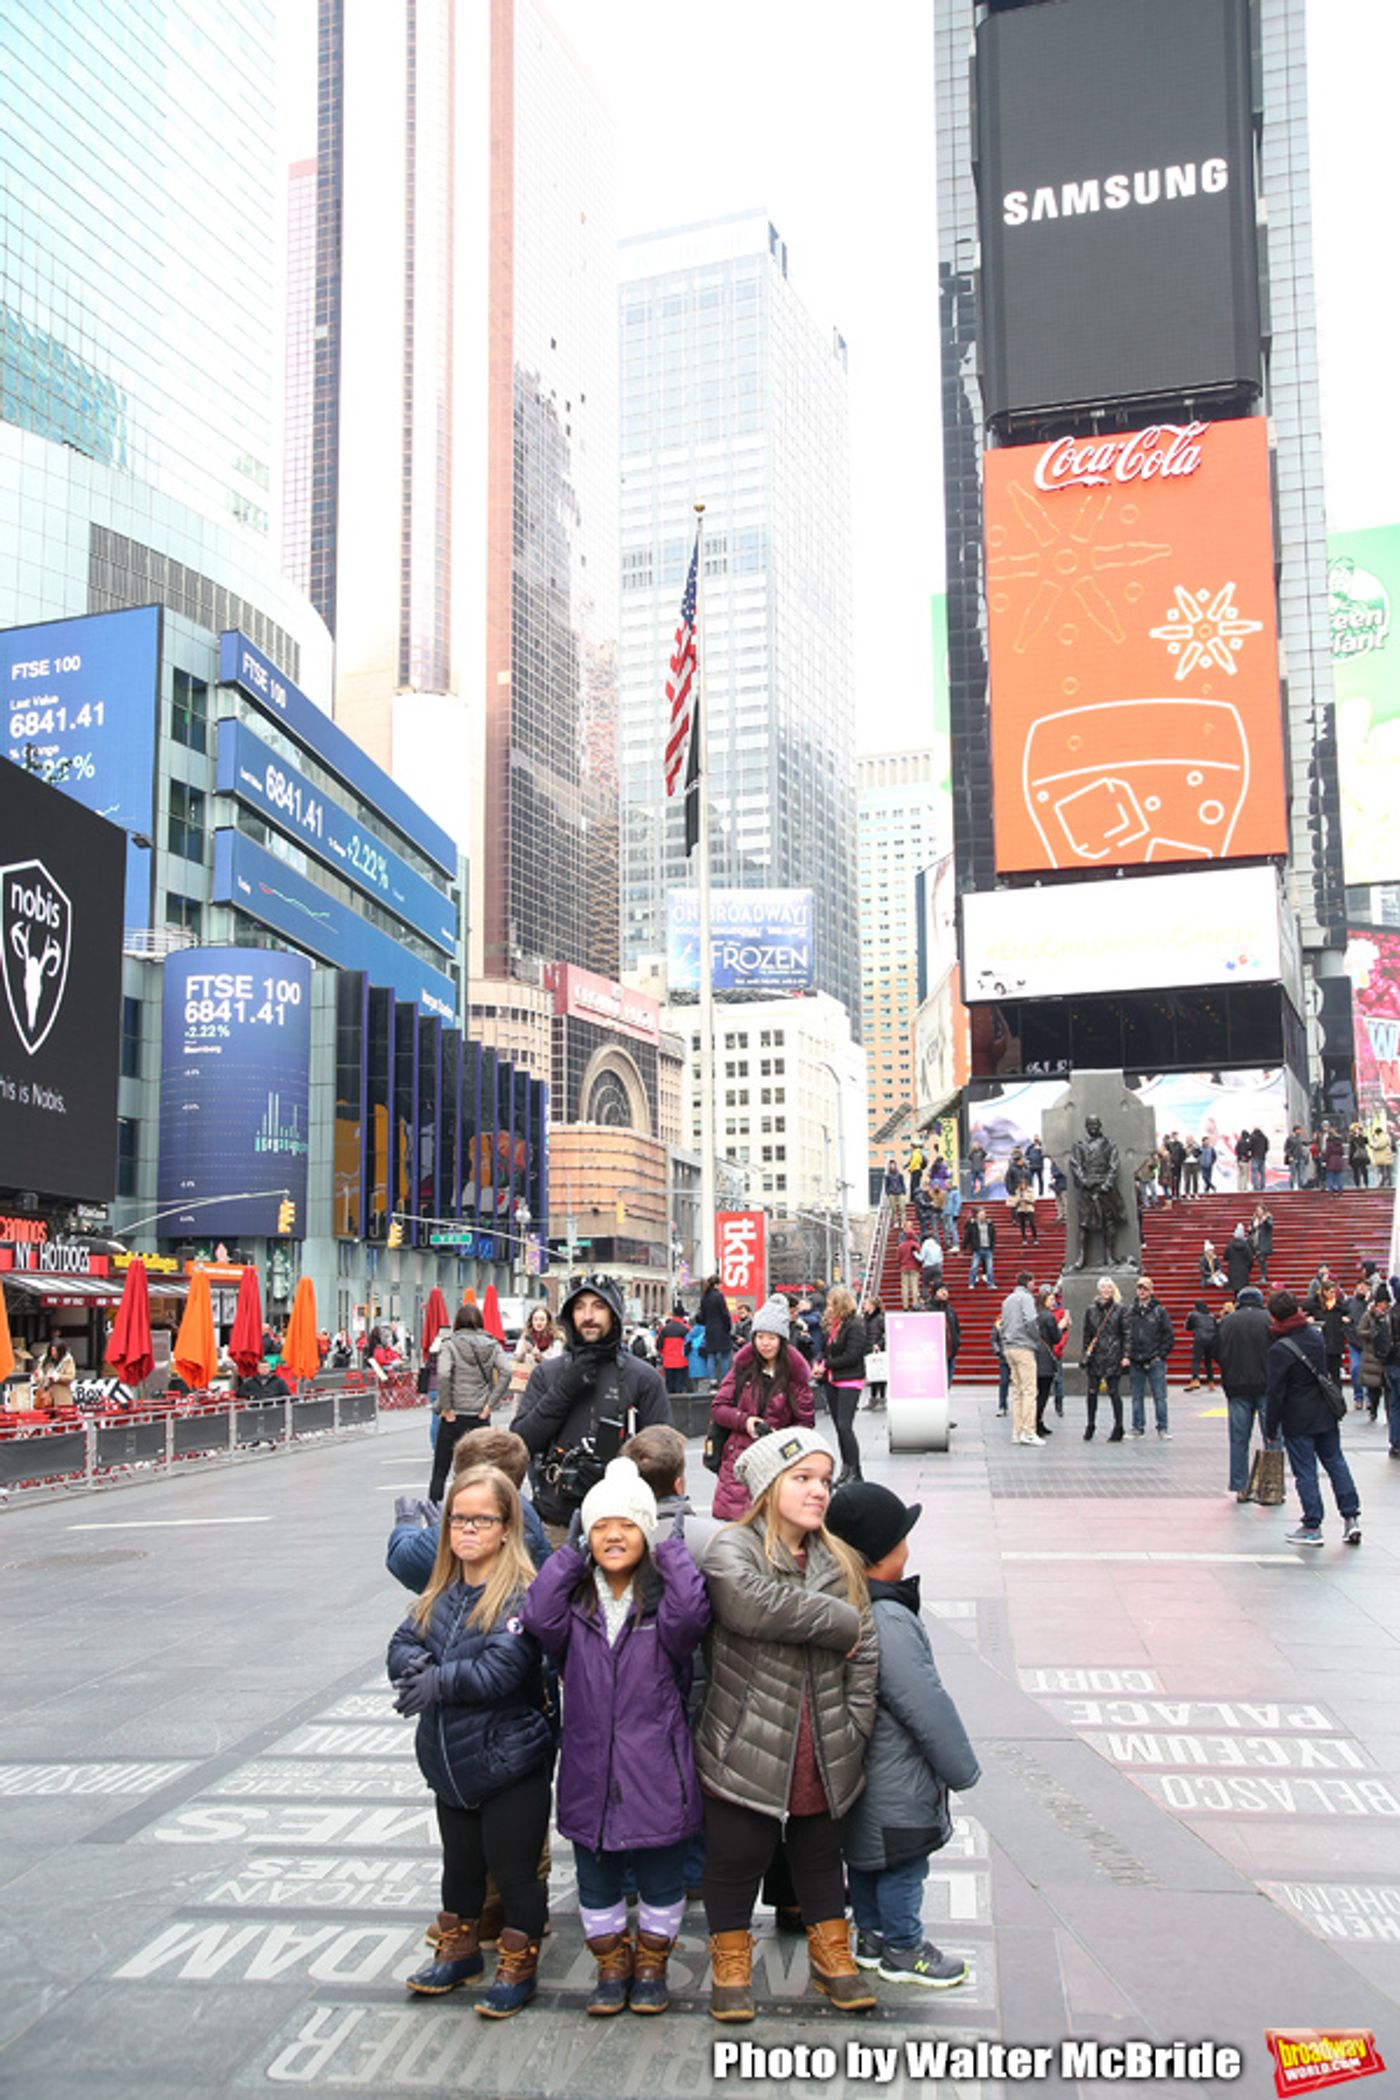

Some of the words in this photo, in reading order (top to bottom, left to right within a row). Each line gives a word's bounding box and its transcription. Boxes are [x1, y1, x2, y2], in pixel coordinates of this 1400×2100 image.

[1003, 158, 1229, 225] SAMSUNG
[1034, 420, 1211, 491] Coca-Cola
[1330, 607, 1385, 630] een
[1331, 626, 1389, 654] iant
[11, 659, 50, 680] FTSE
[54, 655, 81, 673] 100
[242, 651, 269, 692] FTSE
[270, 678, 287, 709] 100
[9, 700, 105, 739] 6841.41
[265, 764, 323, 839] 6841.41
[11, 882, 61, 929] nobis
[711, 940, 808, 975] FROZEN
[186, 973, 254, 1000] FTSE
[262, 977, 301, 1005] 100
[184, 999, 285, 1027] 6841.41
[723, 1217, 757, 1289] tkts
[1031, 1669, 1156, 1693] CORT
[1063, 1699, 1335, 1731] PALACE
[295, 1725, 416, 1755] RIAL
[1104, 1733, 1368, 1770] LYCEUM
[1159, 1774, 1400, 1817] BELASCO
[155, 1803, 440, 1845] MES
